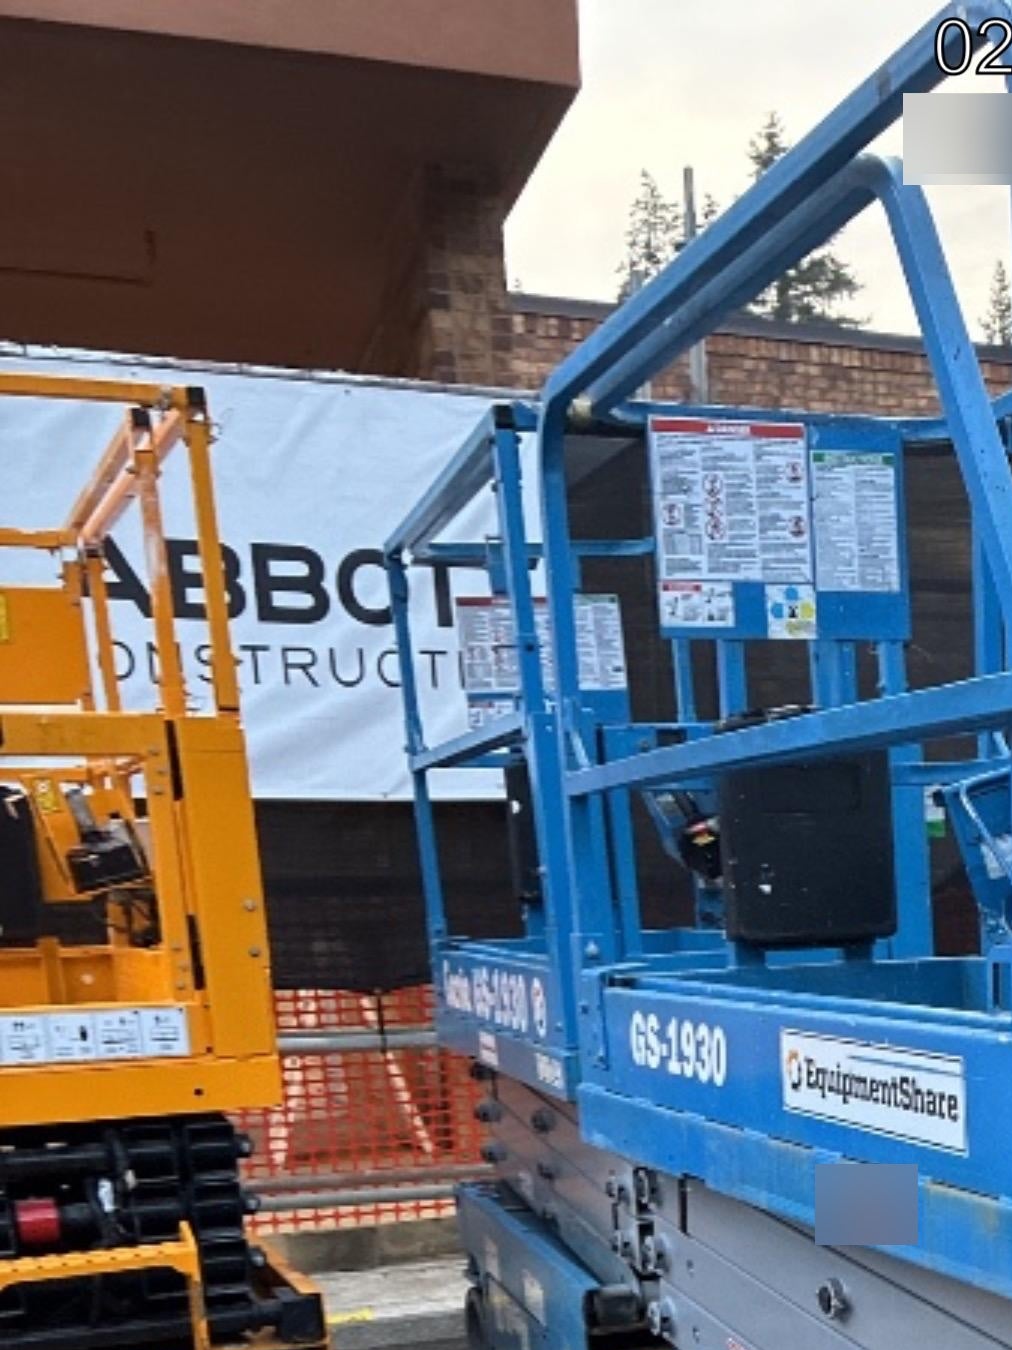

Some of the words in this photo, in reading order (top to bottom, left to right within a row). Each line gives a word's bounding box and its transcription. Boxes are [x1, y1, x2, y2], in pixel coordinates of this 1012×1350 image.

[81, 534, 540, 627] ABBOT
[629, 1010, 727, 1088] GS-1930
[805, 1057, 959, 1122] EquipmentShare
